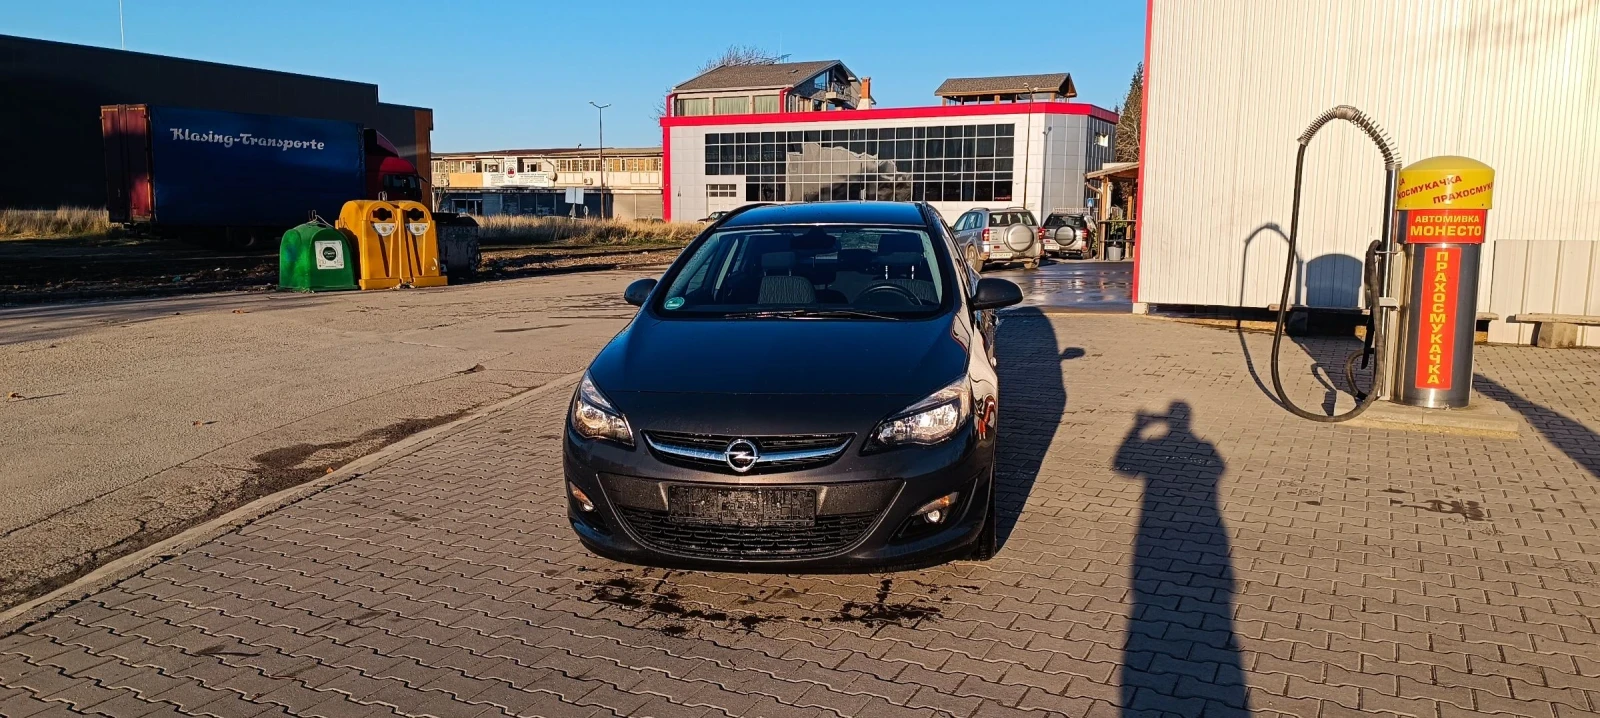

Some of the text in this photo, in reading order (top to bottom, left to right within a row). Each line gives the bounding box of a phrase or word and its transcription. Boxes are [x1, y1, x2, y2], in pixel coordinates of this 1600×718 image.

[170, 128, 325, 151] Klasing-Transporte
[1415, 215, 1479, 223] АВТОМИВКА
[1410, 225, 1482, 237] МОНЕСТО
[1427, 251, 1449, 384] ПРАХОСМУКАЧКА
